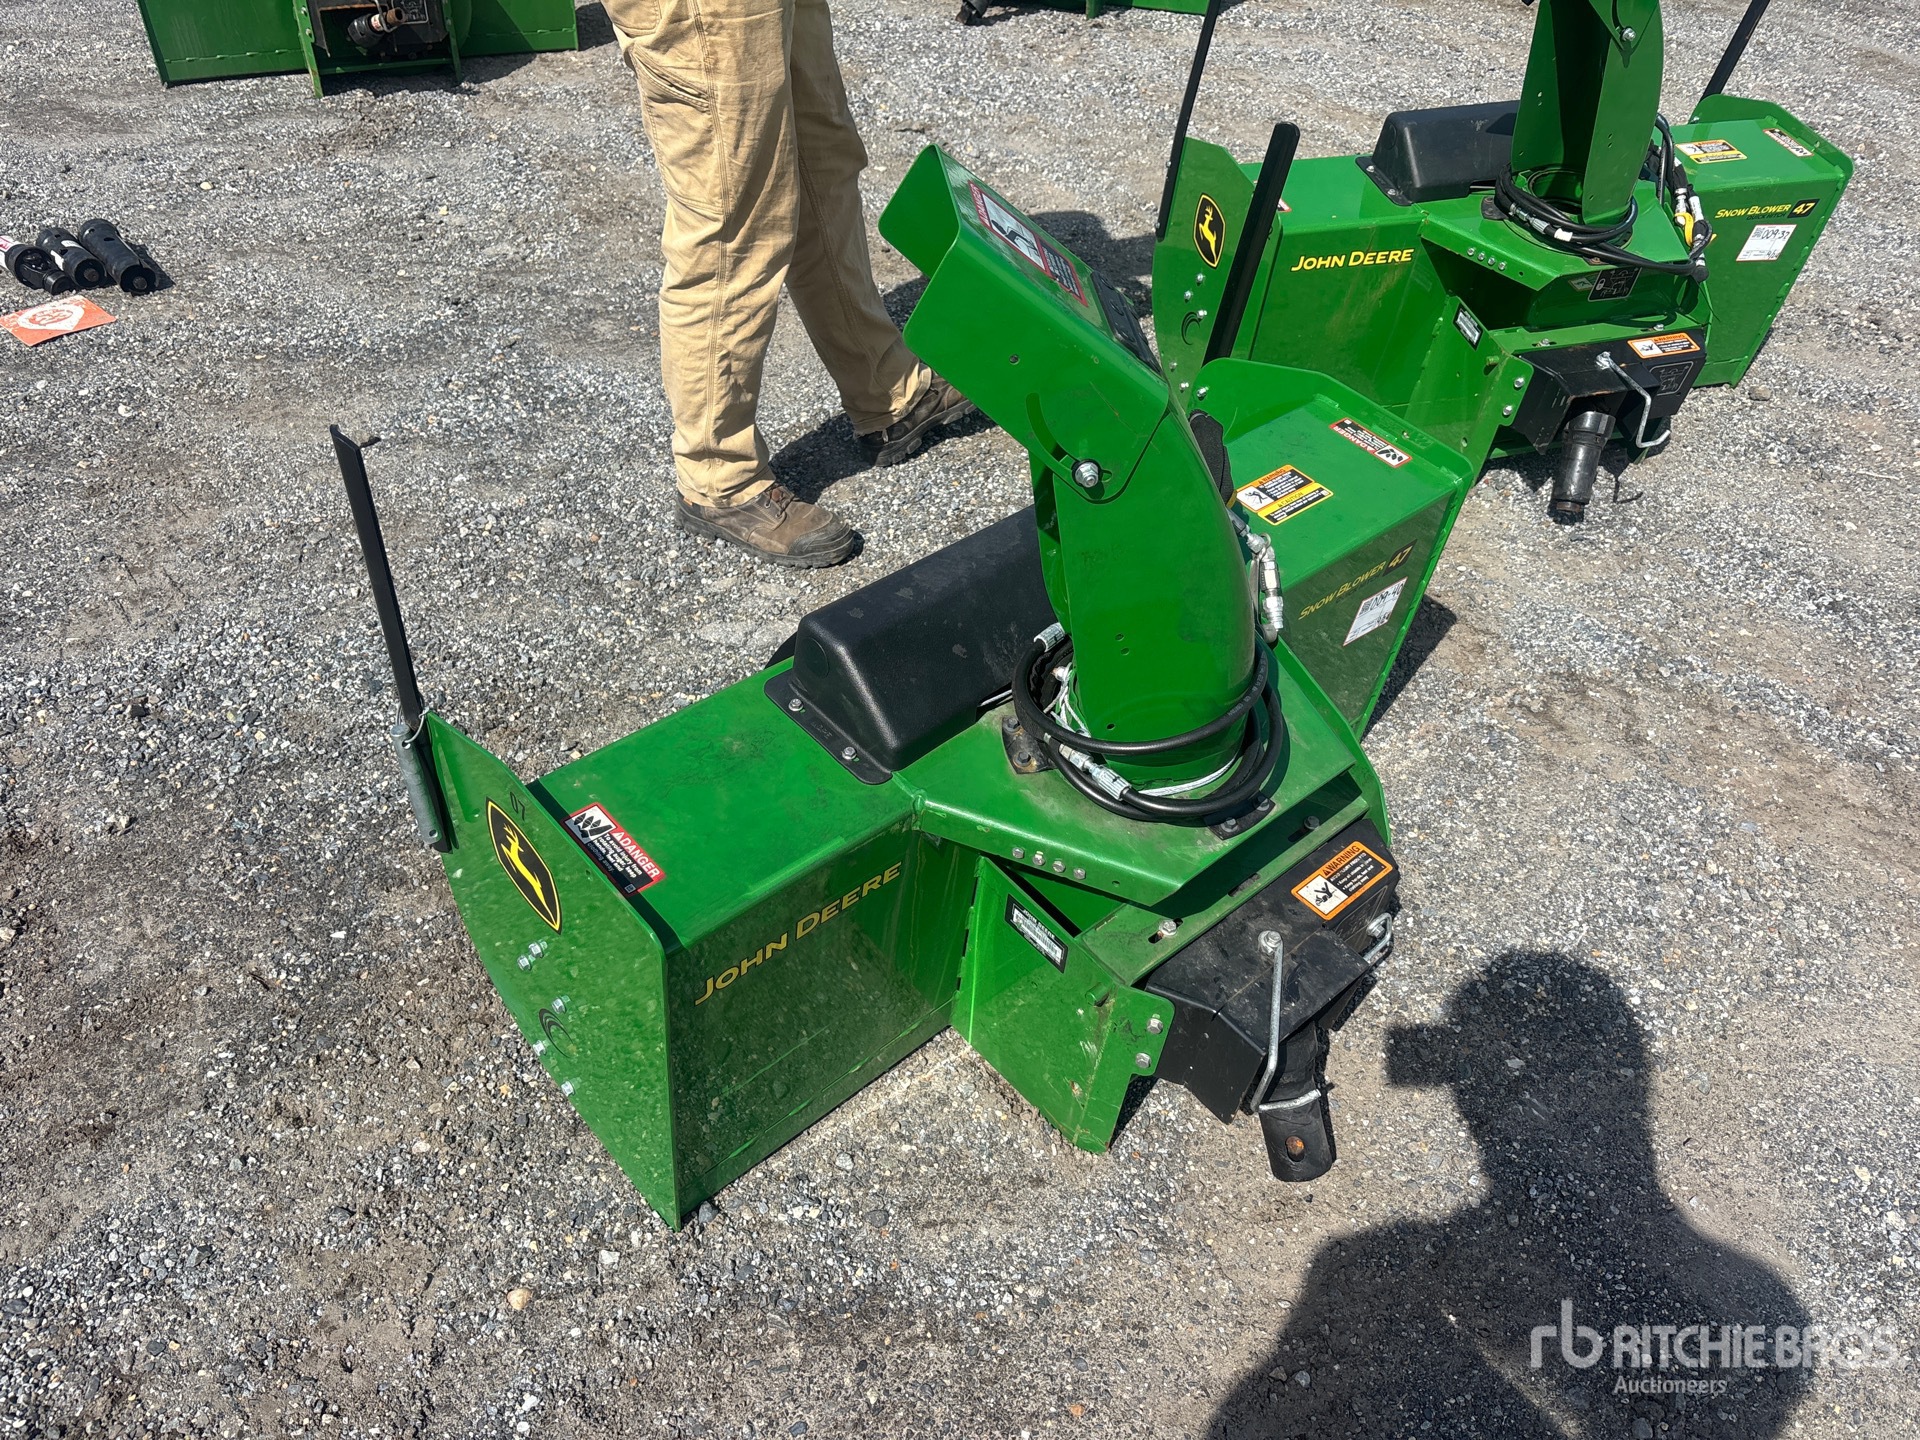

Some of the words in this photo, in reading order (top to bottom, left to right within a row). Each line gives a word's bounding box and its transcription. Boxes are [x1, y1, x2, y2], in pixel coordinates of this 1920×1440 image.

[1715, 208, 1748, 218] SNOW
[1747, 204, 1792, 216] BLOWER
[1793, 202, 1816, 215] 47
[1290, 255, 1346, 272] JOHN
[1348, 248, 1415, 267] DEERE
[1298, 590, 1337, 620] SNOW
[1336, 561, 1387, 597] BLOWER
[1388, 546, 1413, 568] 47
[609, 840, 623, 852] avoid
[619, 851, 633, 865] injury
[631, 864, 643, 875] from
[620, 838, 660, 878] DANGER
[1326, 845, 1361, 872] WARNING
[695, 931, 788, 1006] JOHN
[795, 862, 903, 940] DEERE
